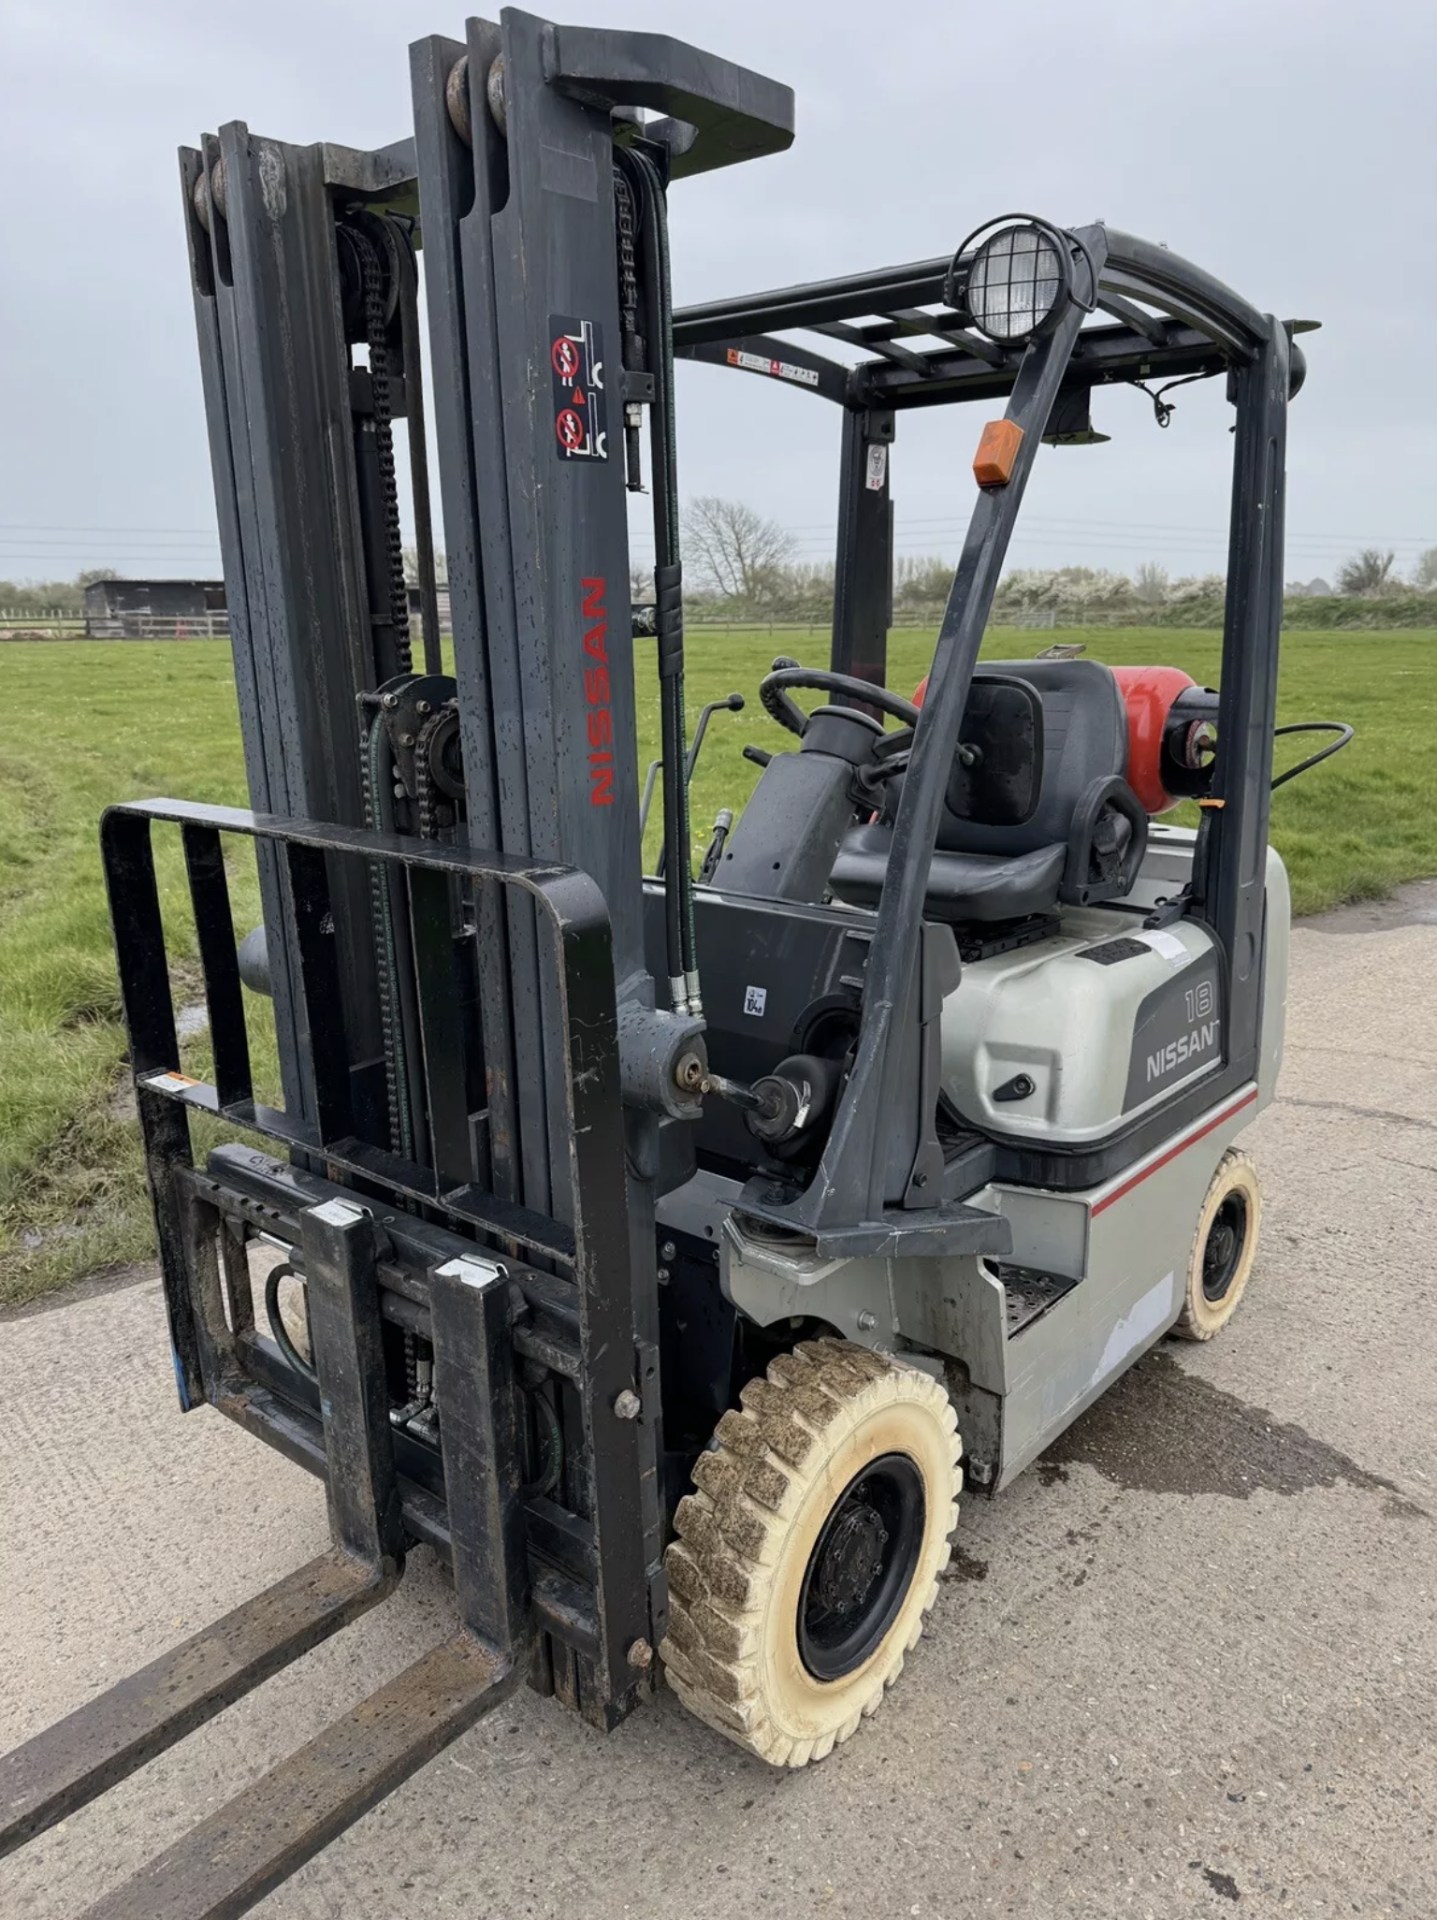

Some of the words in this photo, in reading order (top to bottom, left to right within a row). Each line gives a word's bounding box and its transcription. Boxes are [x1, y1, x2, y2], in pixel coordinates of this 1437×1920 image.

[581, 578, 614, 807] NISSAN
[1185, 980, 1214, 1023] 18
[1146, 1021, 1213, 1082] NISSAN
